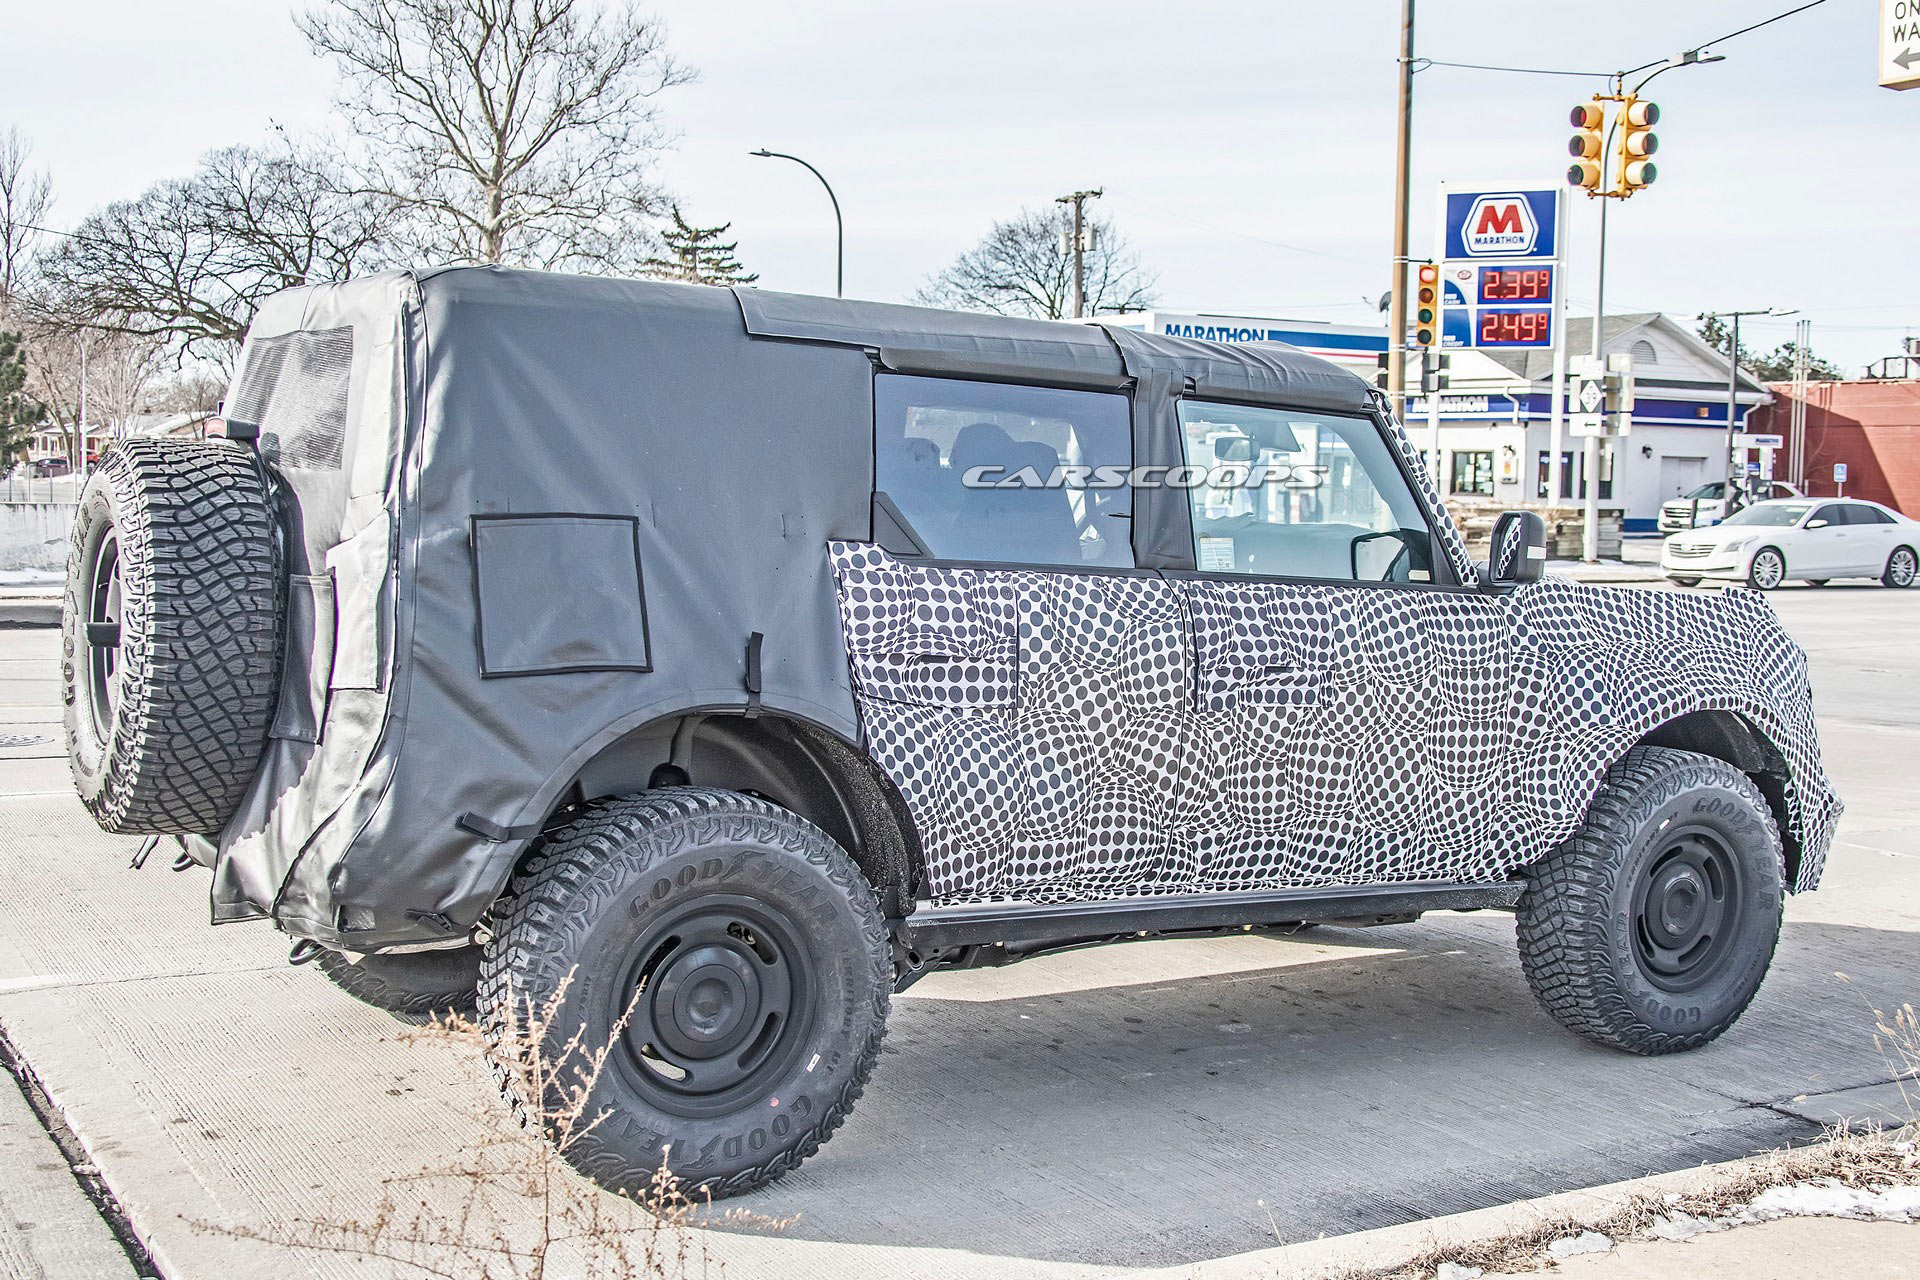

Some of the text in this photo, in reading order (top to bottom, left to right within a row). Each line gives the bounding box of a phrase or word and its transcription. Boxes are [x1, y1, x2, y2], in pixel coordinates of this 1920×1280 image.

[1476, 205, 1523, 234] M
[1474, 235, 1524, 244] MARATHON
[1165, 323, 1264, 343] MARATHON
[629, 851, 839, 923] GOODYEAR
